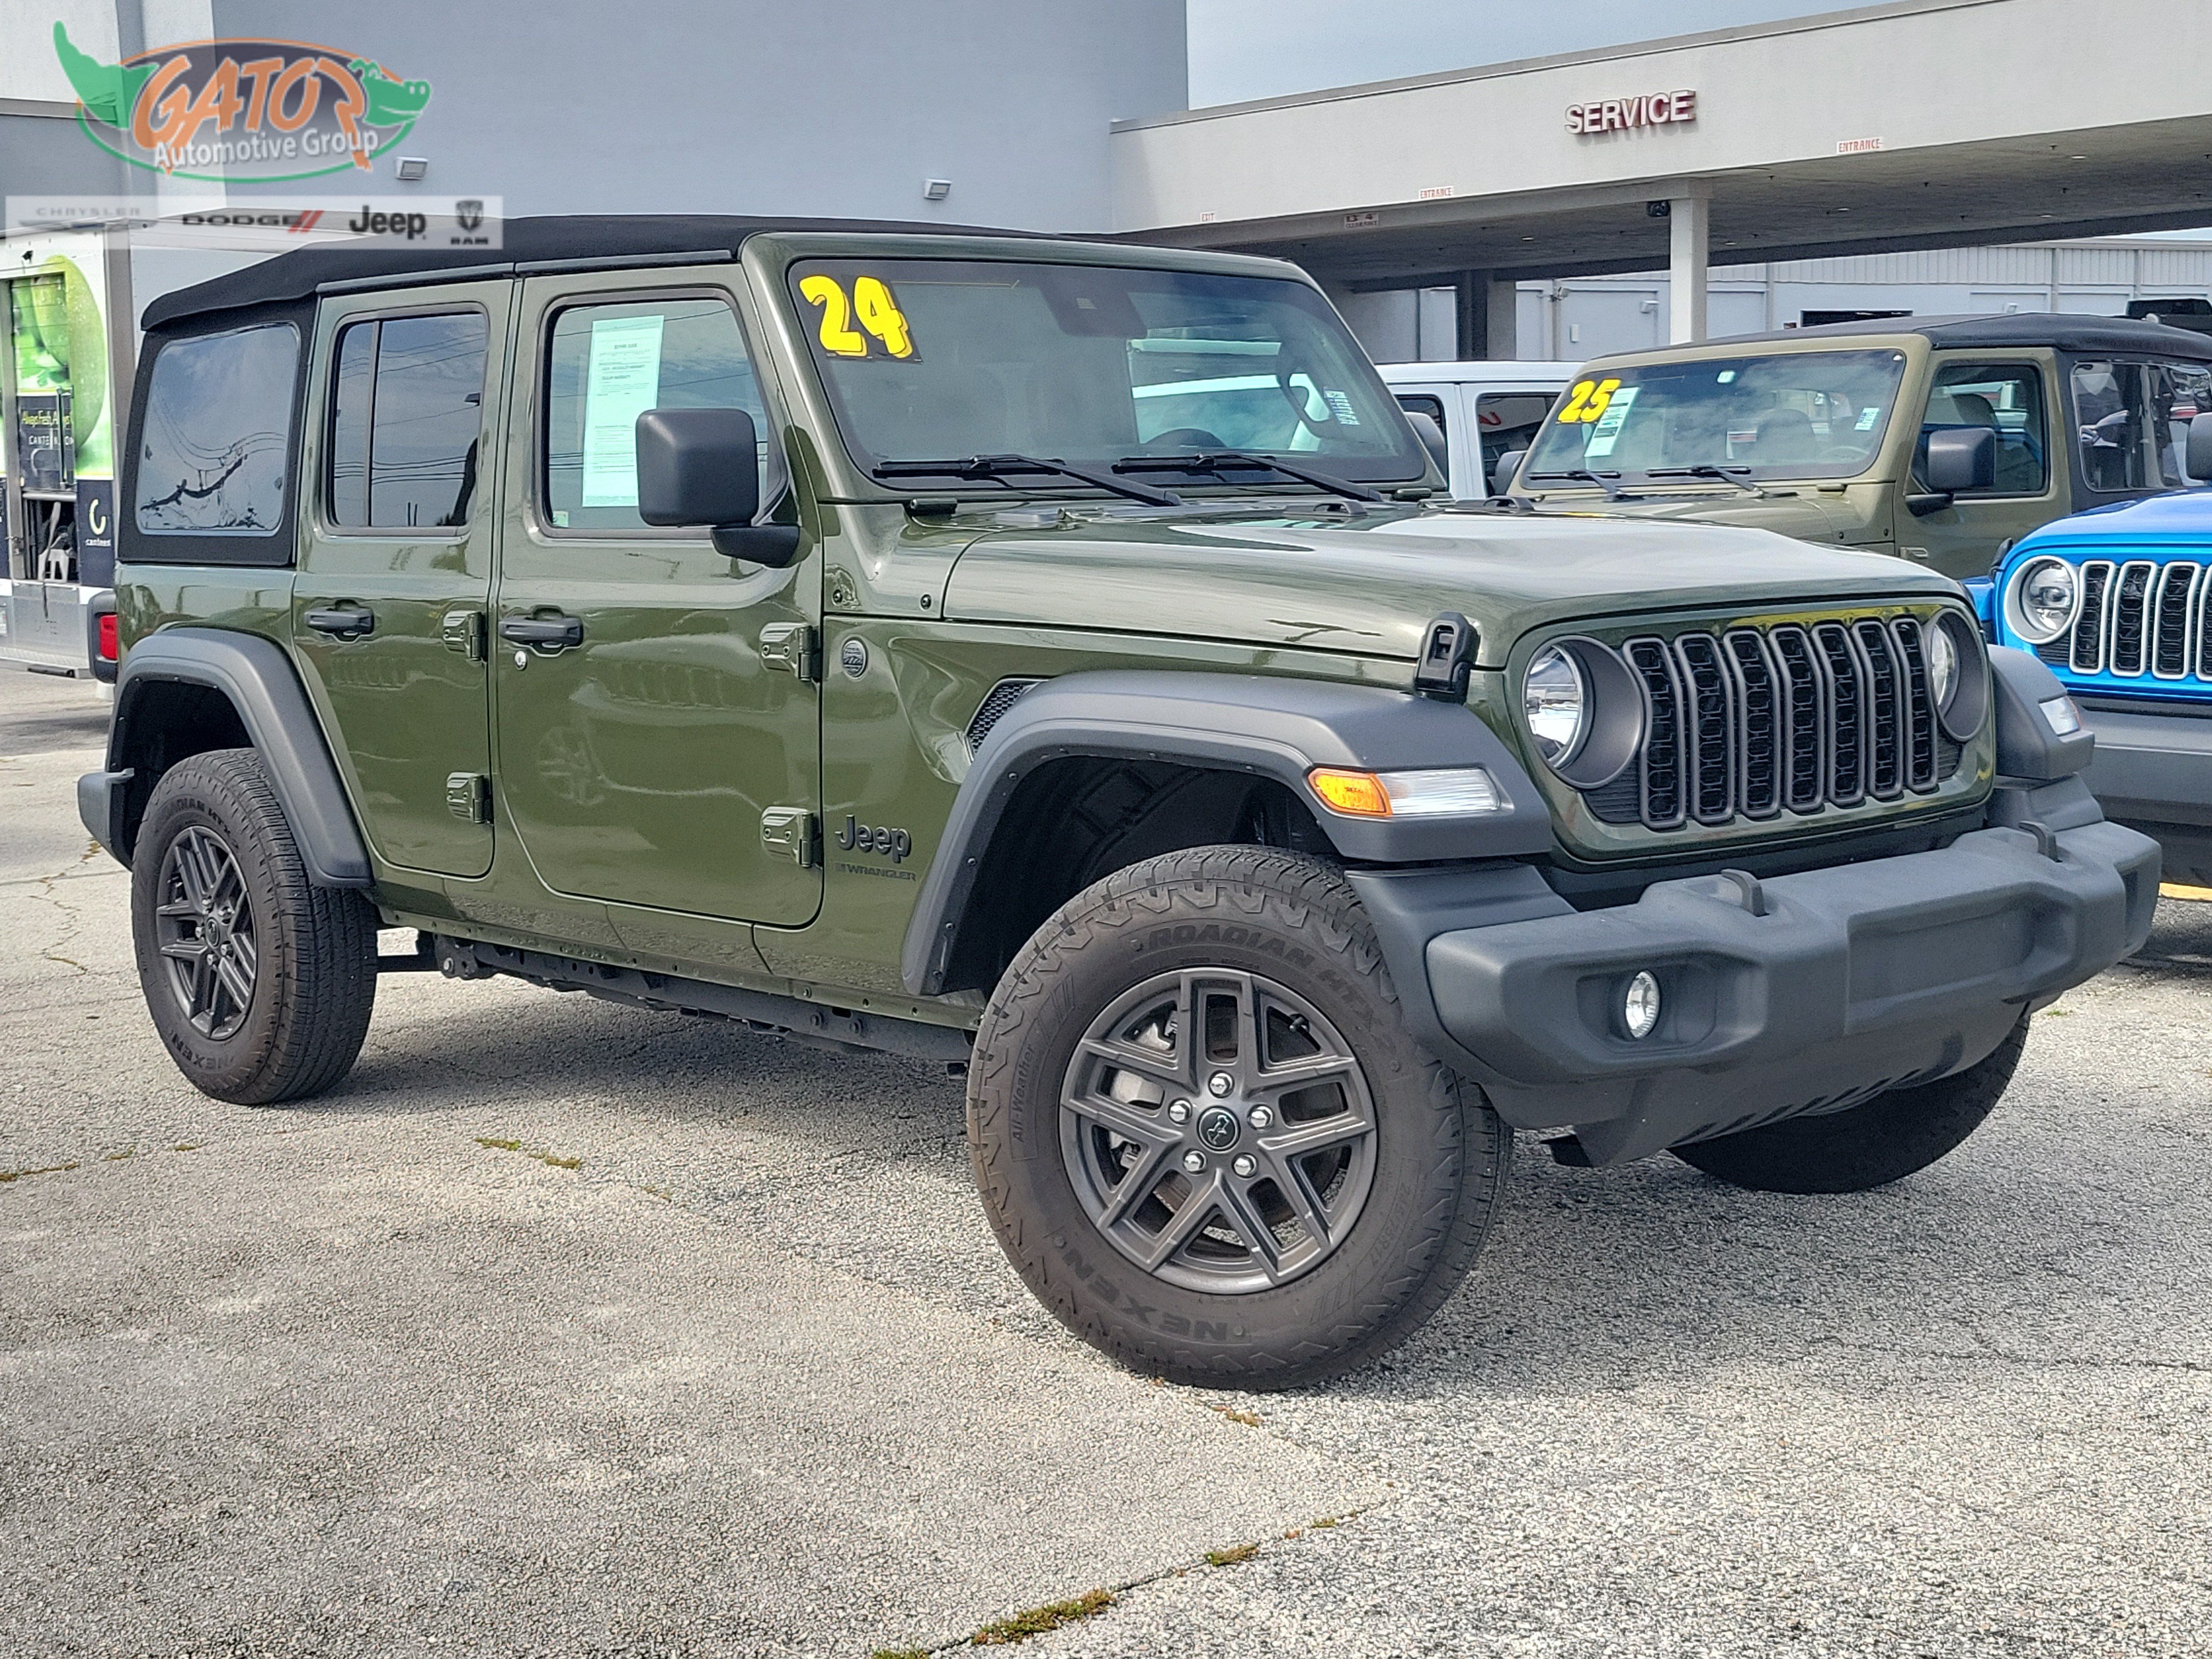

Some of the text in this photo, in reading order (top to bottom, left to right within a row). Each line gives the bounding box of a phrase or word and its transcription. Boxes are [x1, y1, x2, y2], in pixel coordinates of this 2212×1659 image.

[1564, 89, 1696, 134] SERVICE
[1838, 138, 1880, 153] ENTRANCE
[1419, 187, 1452, 199] ENTRANCE
[799, 275, 913, 359] 24
[1558, 379, 1622, 422] 25
[834, 814, 912, 864] Jeep
[847, 864, 917, 881] WRANGLER
[1148, 923, 1317, 970] ROADIAN
[1012, 1043, 1036, 1143] All-Weather
[1061, 1248, 1229, 1341] NEXEN
